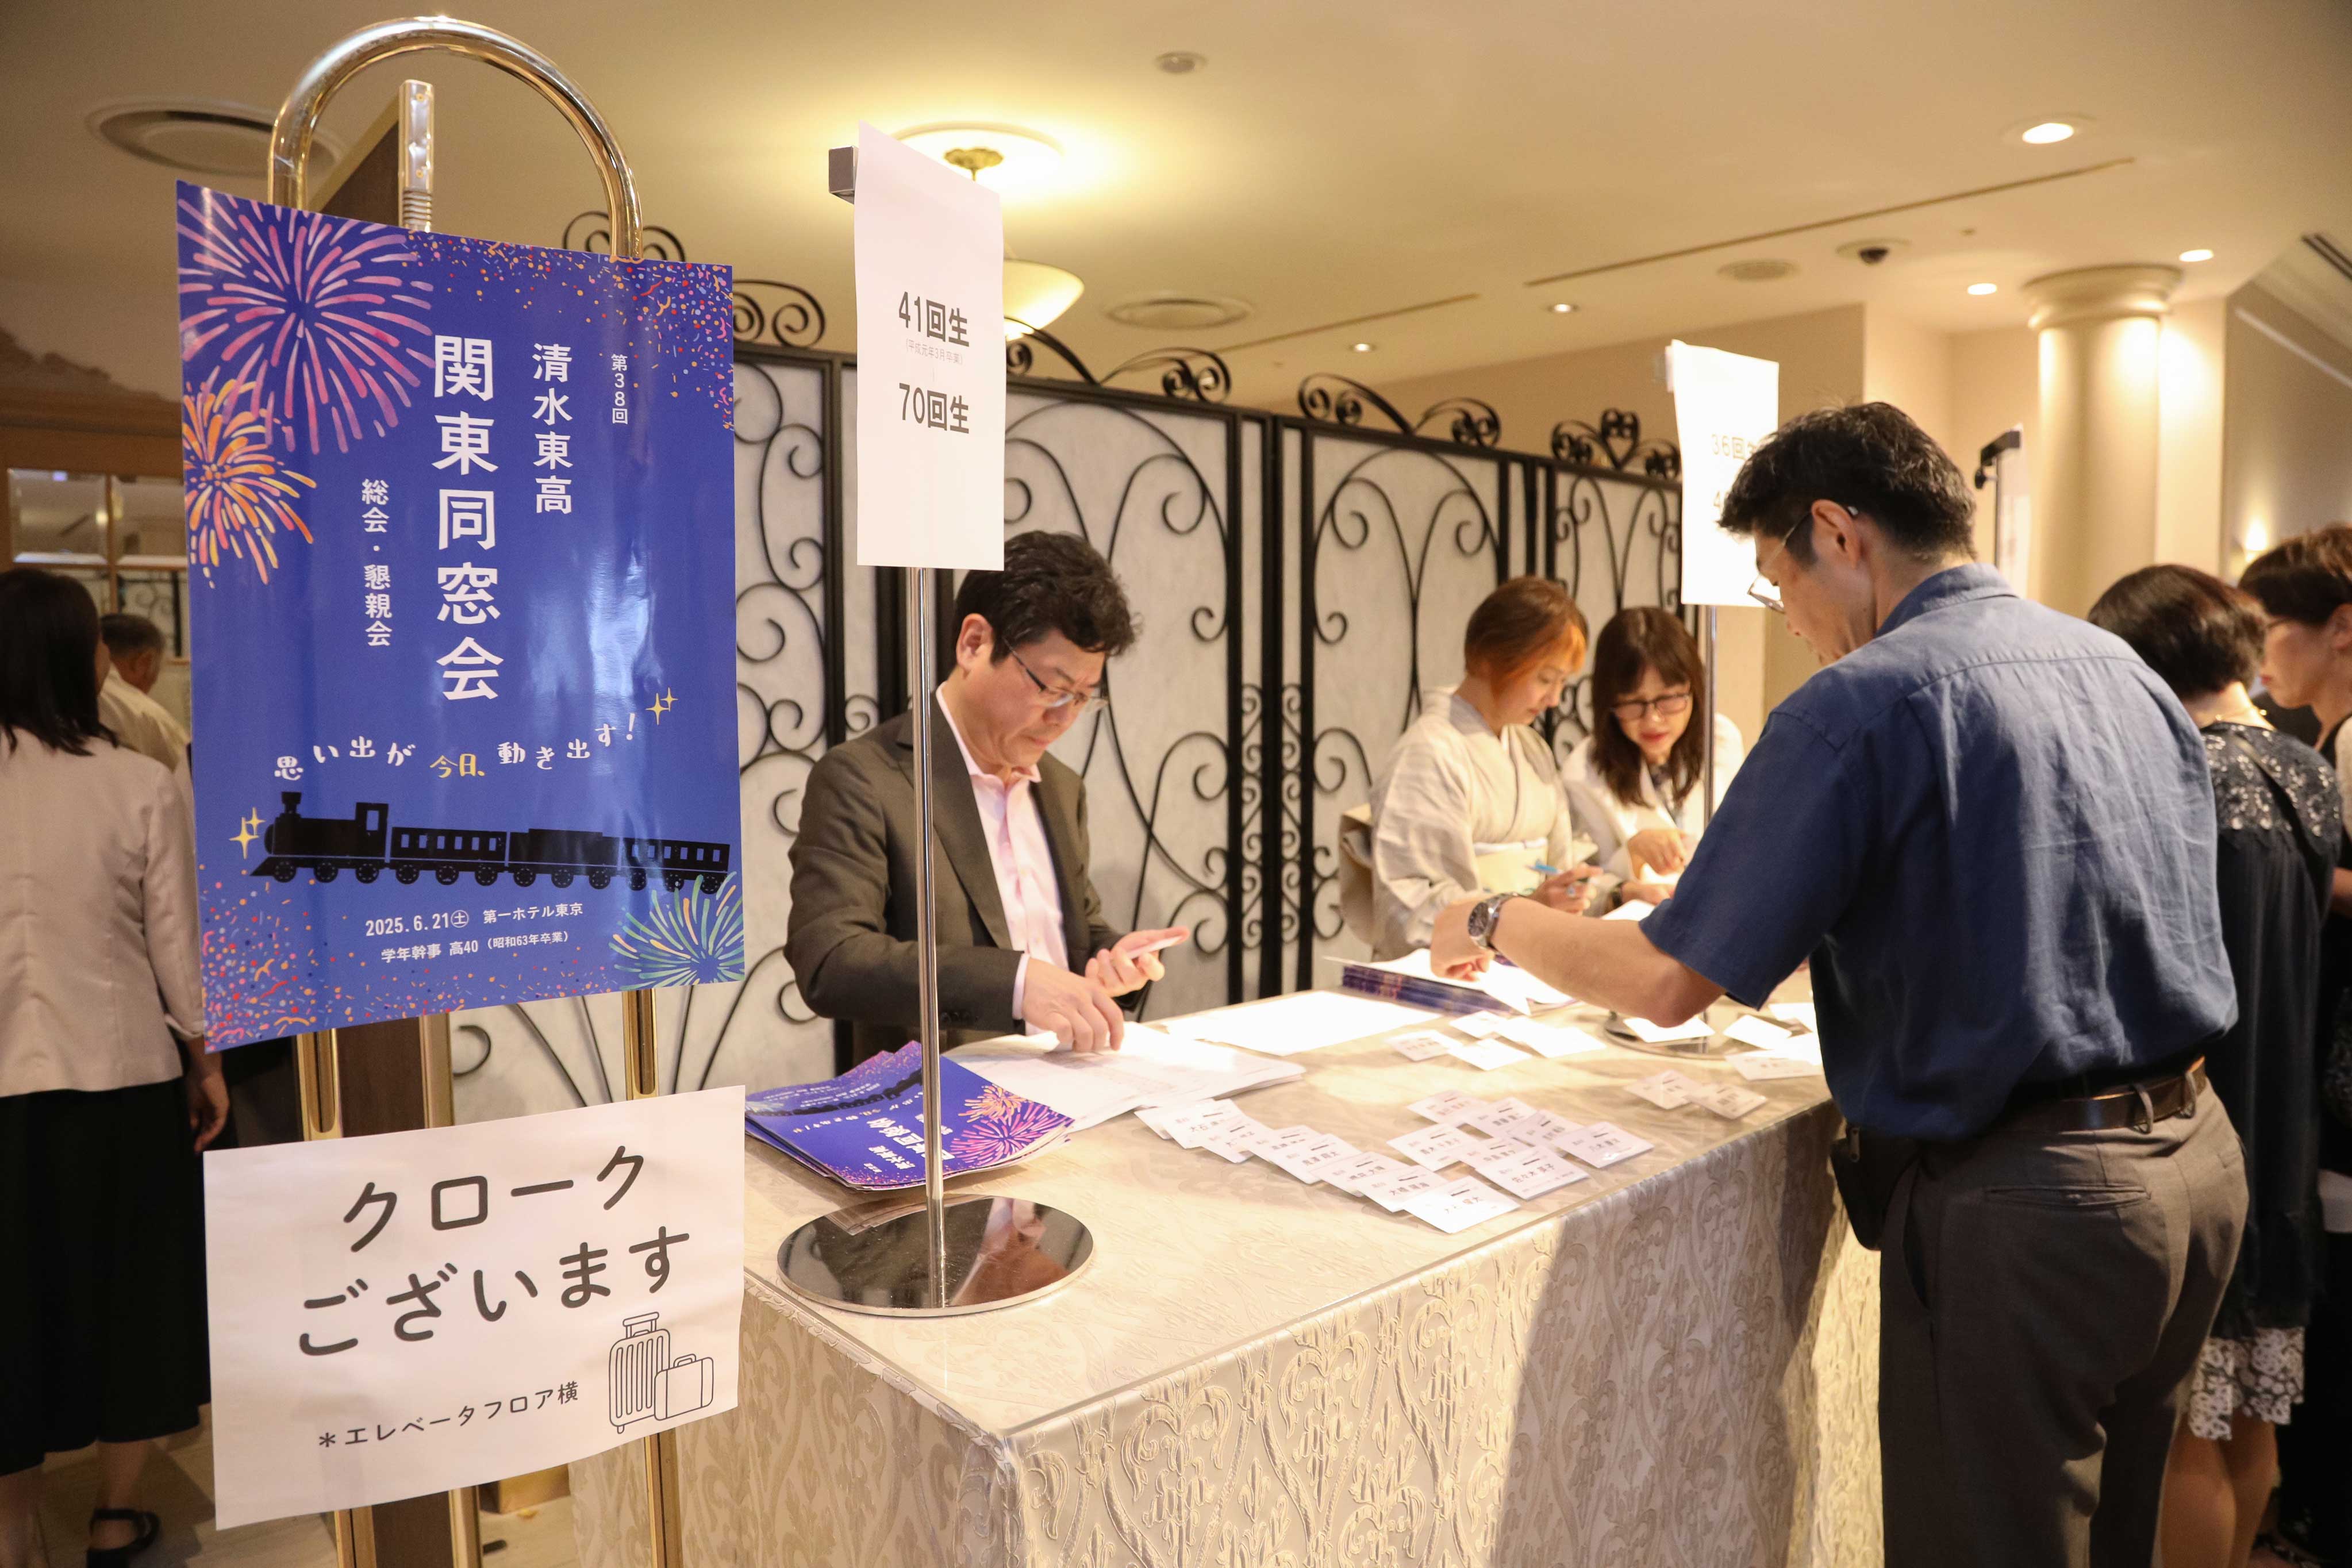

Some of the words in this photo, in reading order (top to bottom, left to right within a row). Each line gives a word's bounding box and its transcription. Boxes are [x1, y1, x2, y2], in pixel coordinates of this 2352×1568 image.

[898, 291, 969, 347] 41回生
[611, 353, 628, 425] 第38回
[899, 383, 969, 434] 70回生
[532, 343, 573, 515] 清水東高
[432, 335, 504, 701] 関東同窓会
[362, 478, 392, 647] 総会・懇親会
[274, 735, 416, 781] 思い出が
[483, 902, 583, 924] 第一ホテル東京
[381, 943, 441, 963] 学年幹事
[449, 940, 478, 956] 高40
[343, 1146, 644, 1252] クローク
[299, 1225, 690, 1357] ございます
